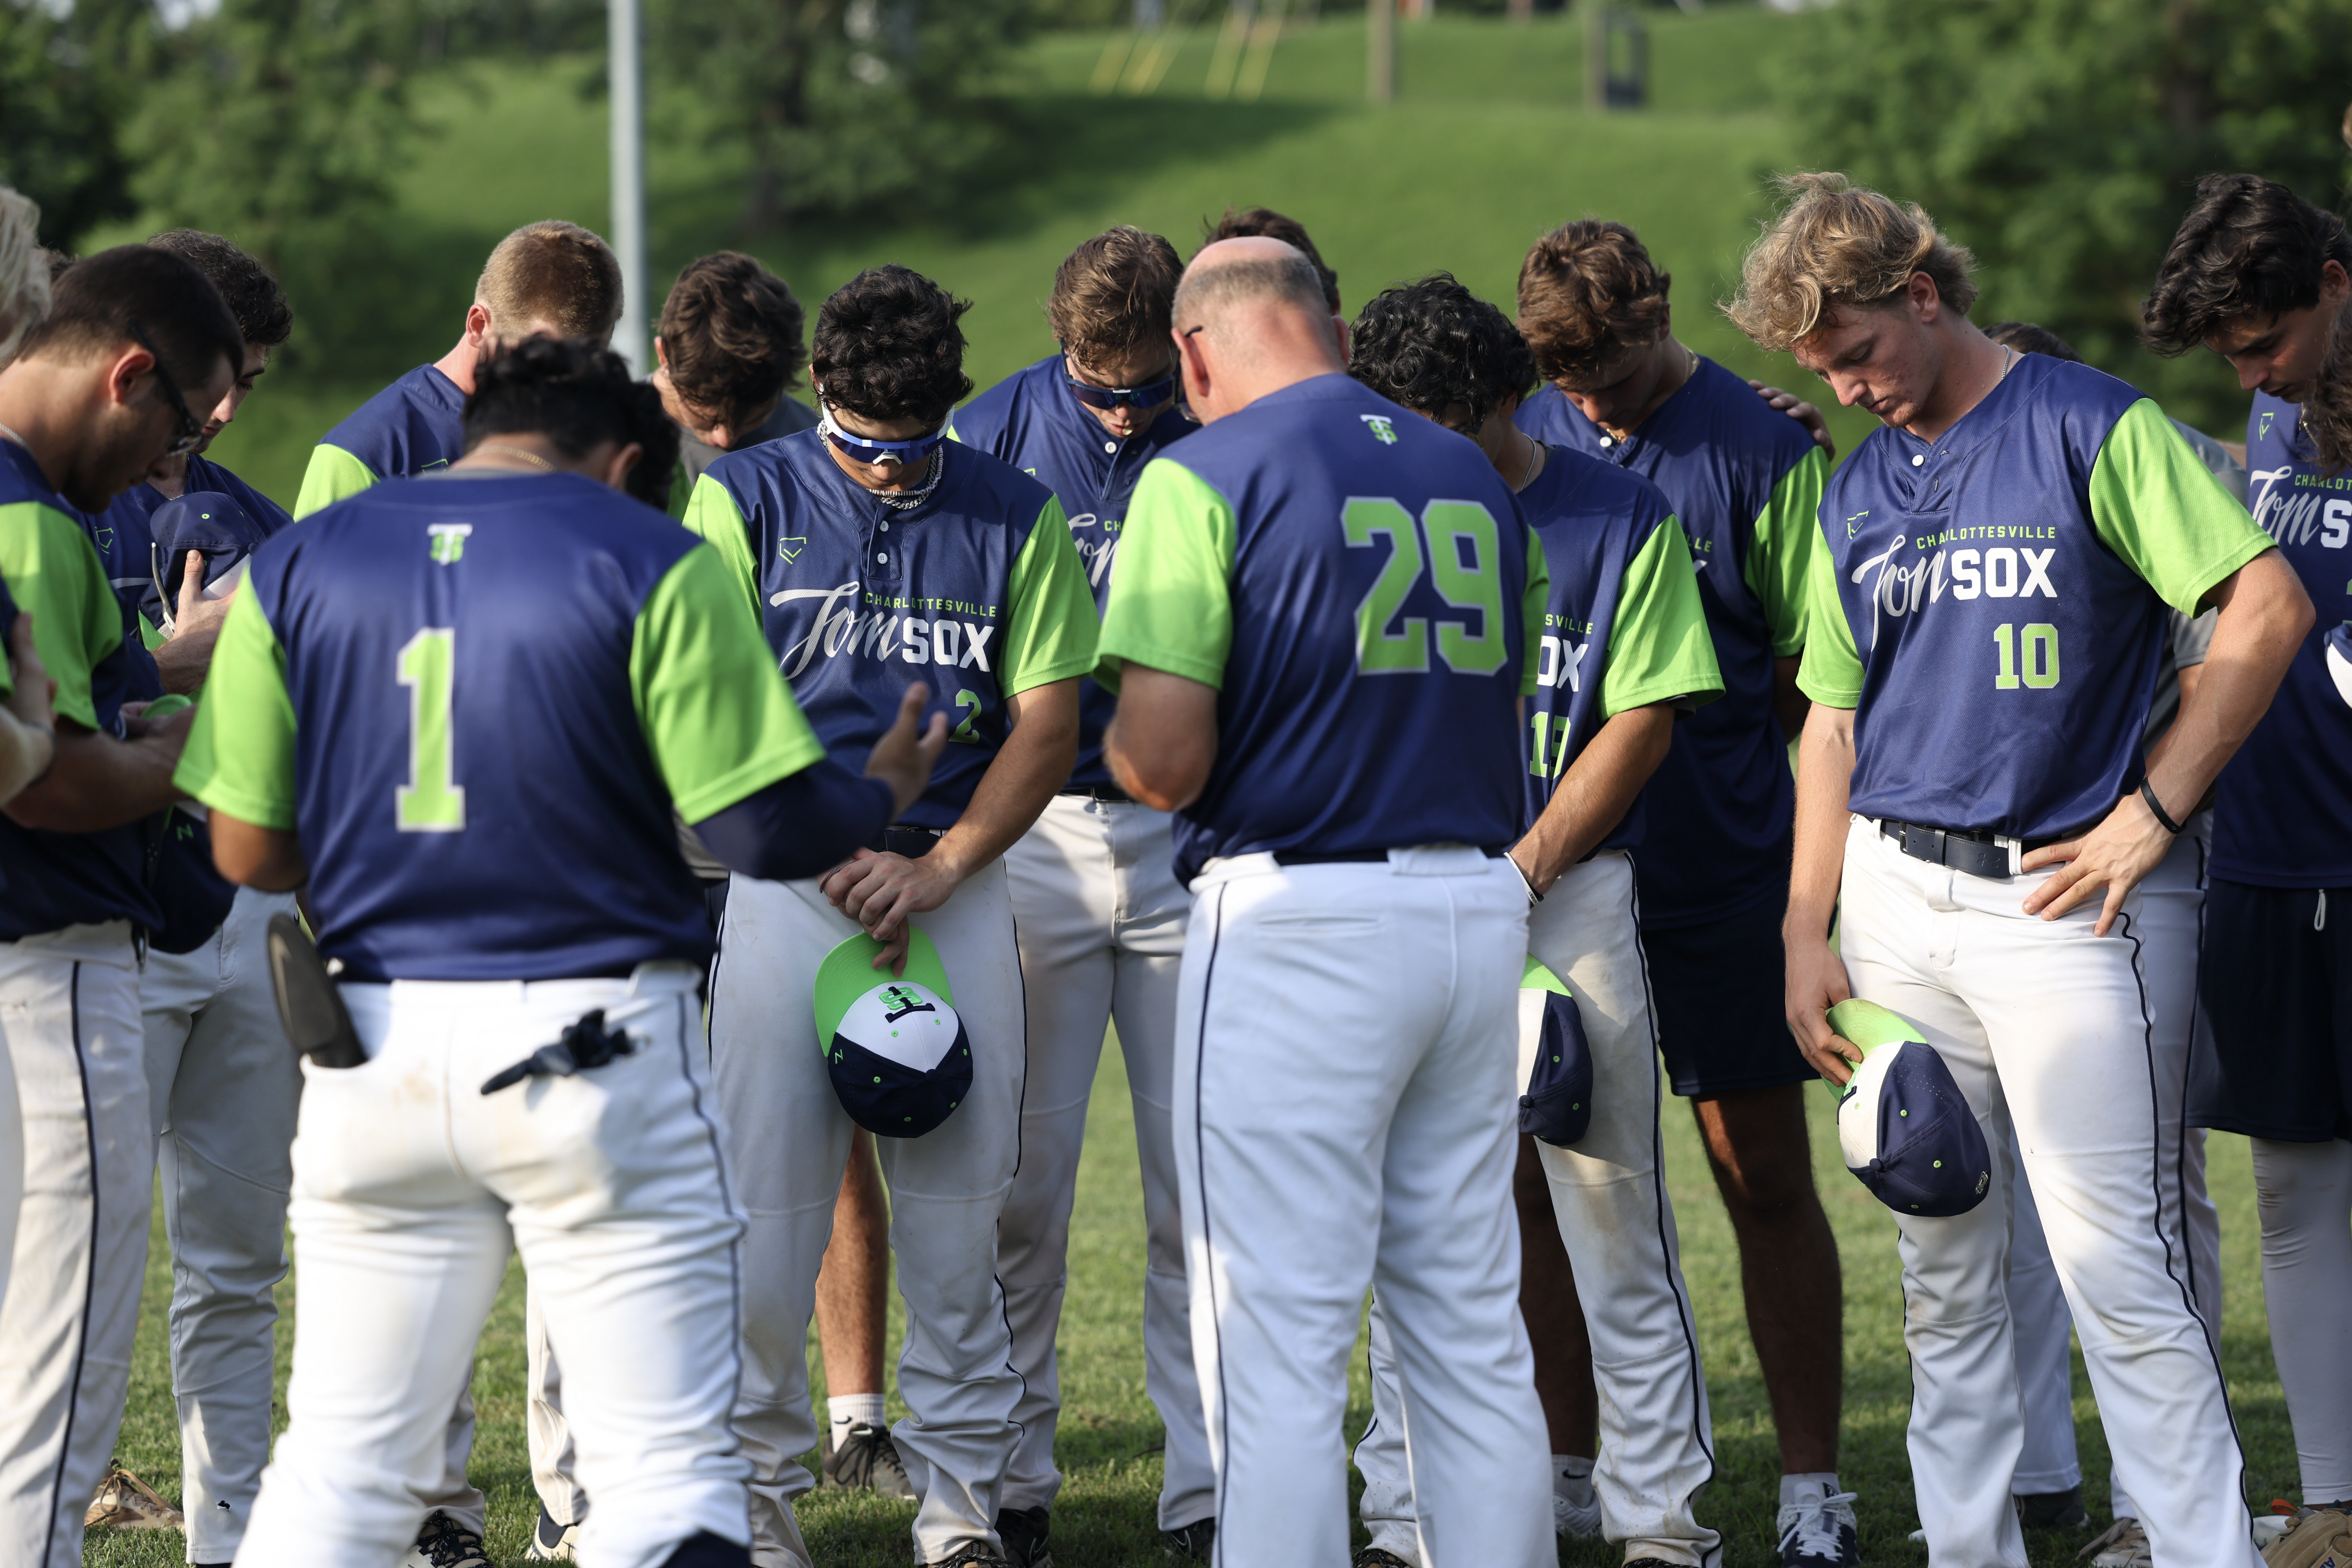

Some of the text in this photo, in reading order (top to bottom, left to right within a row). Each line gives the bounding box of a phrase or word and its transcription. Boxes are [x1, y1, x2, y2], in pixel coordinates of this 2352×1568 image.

[865, 592, 997, 618] CHARLOTTESVILLE
[1339, 496, 1508, 676] 29
[1993, 623, 2060, 690] 10
[396, 626, 466, 832] 1
[948, 688, 982, 744] 2
